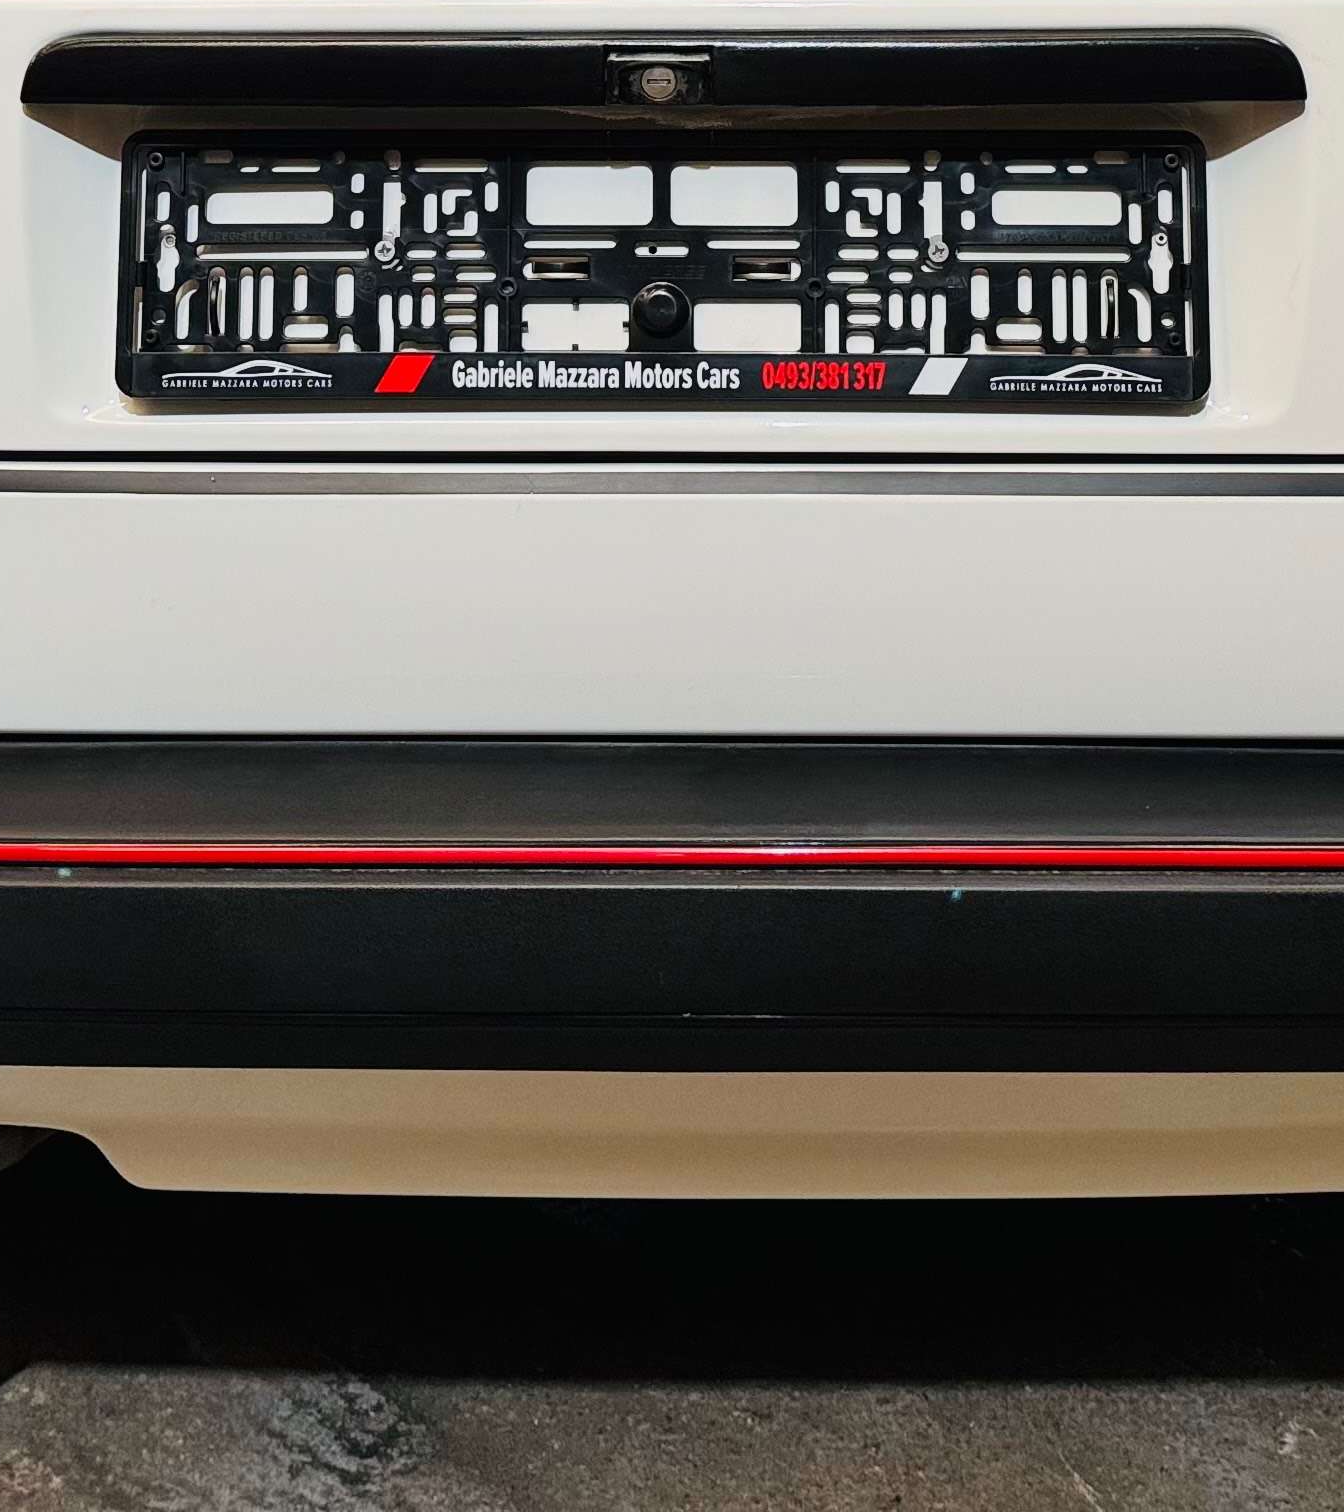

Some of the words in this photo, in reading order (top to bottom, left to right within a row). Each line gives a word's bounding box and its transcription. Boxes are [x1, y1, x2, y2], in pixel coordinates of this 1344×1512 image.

[452, 360, 534, 390] Gabriele
[538, 361, 620, 390] Mazzara
[625, 361, 693, 390] Motors
[697, 361, 741, 390] Cars
[161, 379, 208, 389] GABRIELE
[212, 379, 259, 389] MAZZARA
[263, 378, 303, 389] MOTORS
[307, 378, 333, 389] CARS
[989, 382, 1037, 393] GABRIELE
[1040, 382, 1089, 393] MAZZARA
[1091, 381, 1133, 393] MOTORS
[1136, 382, 1163, 393] CARS
